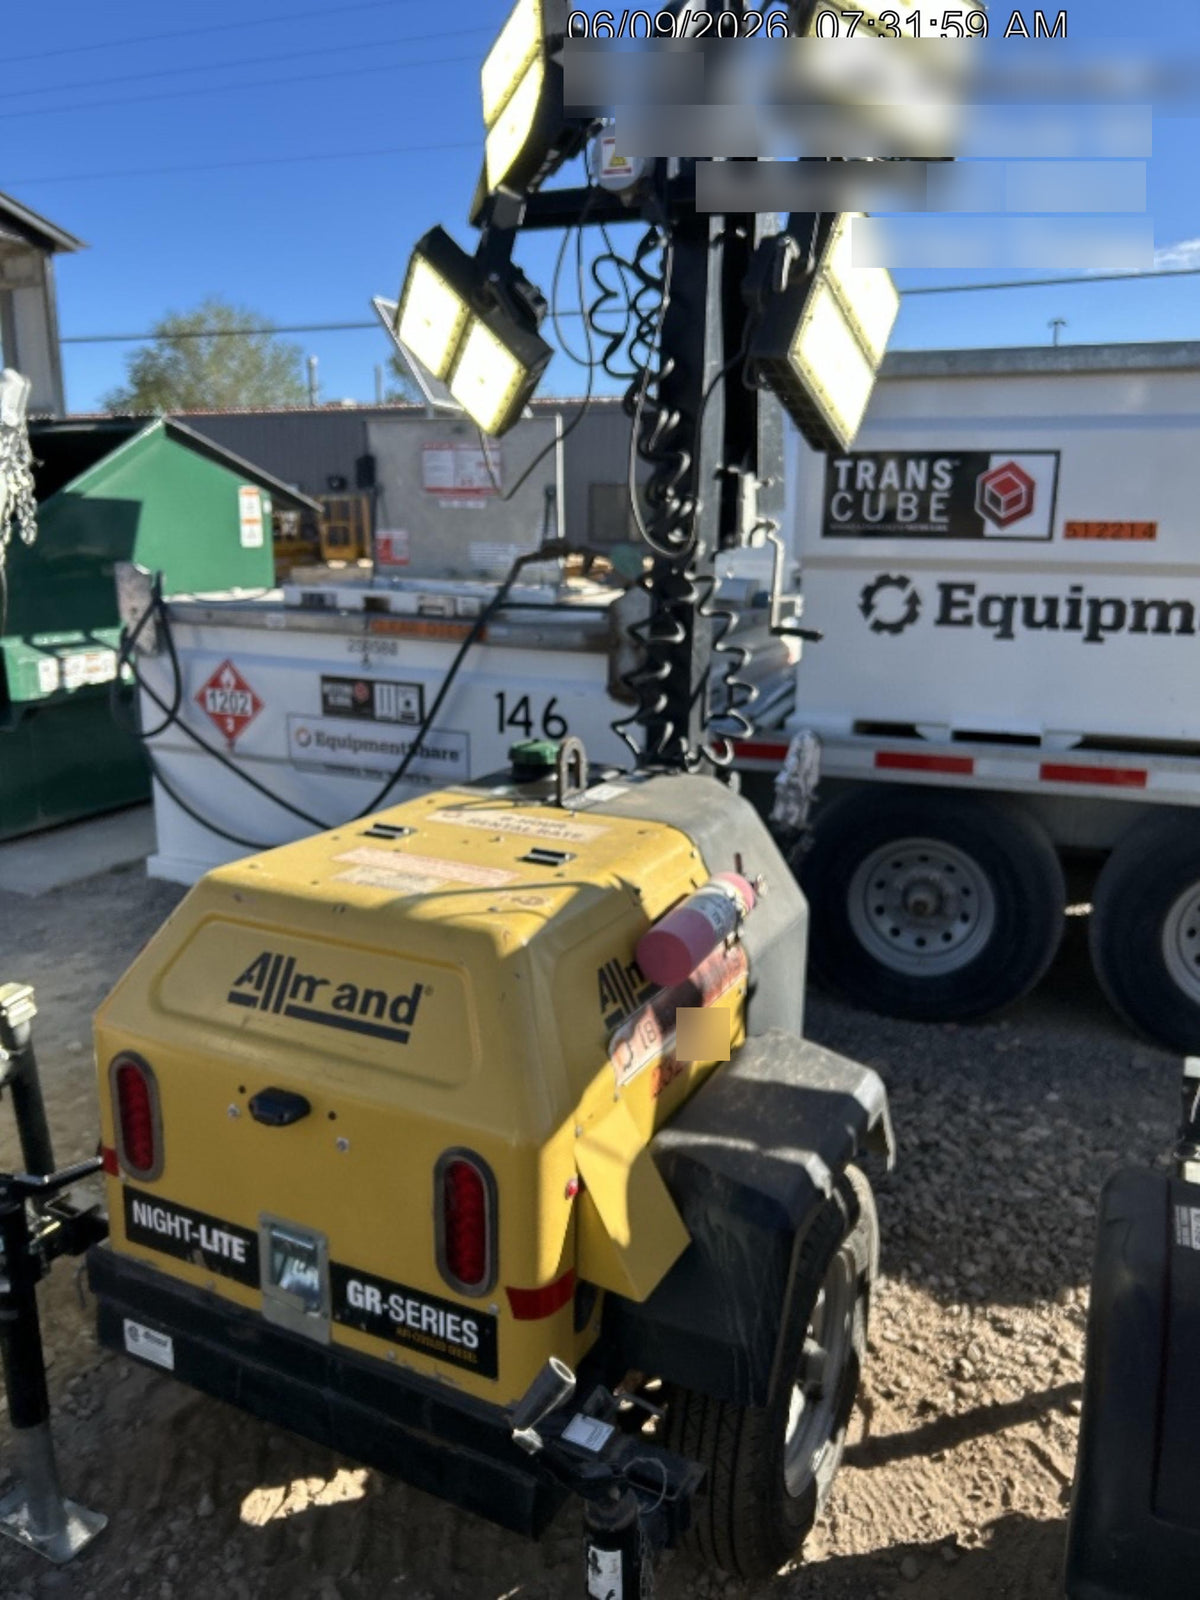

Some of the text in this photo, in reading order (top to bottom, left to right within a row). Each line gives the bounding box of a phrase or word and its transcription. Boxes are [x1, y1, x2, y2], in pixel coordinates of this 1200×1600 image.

[833, 459, 952, 492] TRANS
[830, 491, 950, 523] CUBE
[934, 582, 1196, 643] Equipm
[208, 691, 250, 715] 1202
[495, 692, 568, 740] 146
[233, 951, 423, 1026] Allmand
[132, 1200, 246, 1263] NIGHT-LITE
[346, 1279, 479, 1348] GR-SERIES
